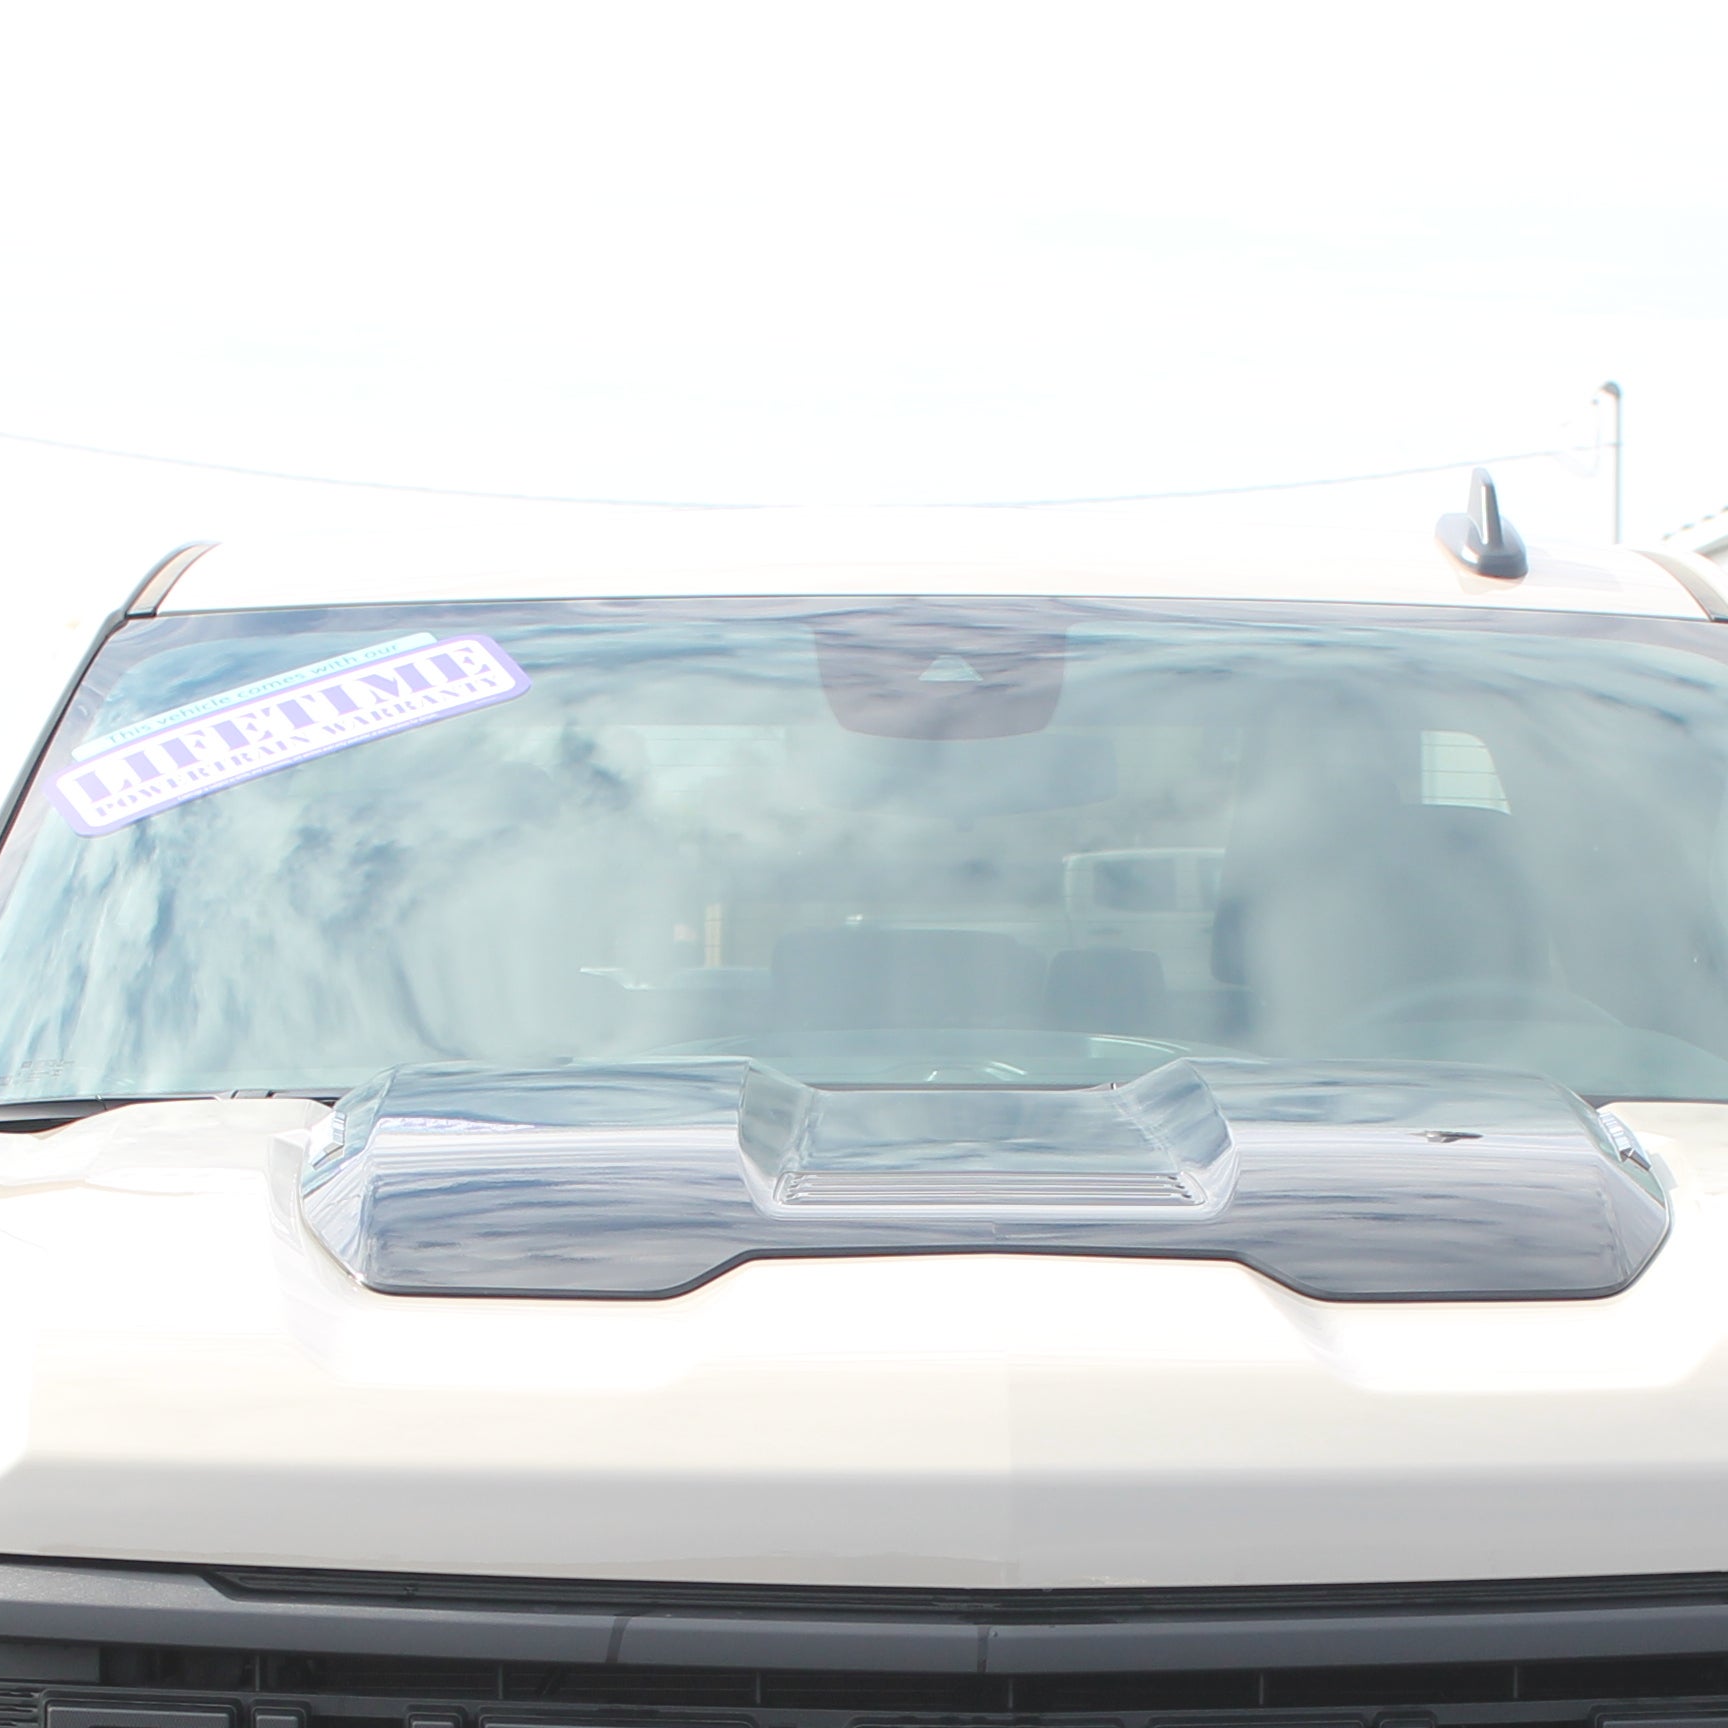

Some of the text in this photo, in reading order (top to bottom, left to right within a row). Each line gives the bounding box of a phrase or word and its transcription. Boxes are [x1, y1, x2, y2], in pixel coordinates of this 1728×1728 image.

[73, 646, 493, 804] LIFETIME
[95, 734, 312, 818] POWERTRAIN
[320, 676, 500, 736] WARRANTY
[108, 643, 399, 744] This vehicle comes with our
